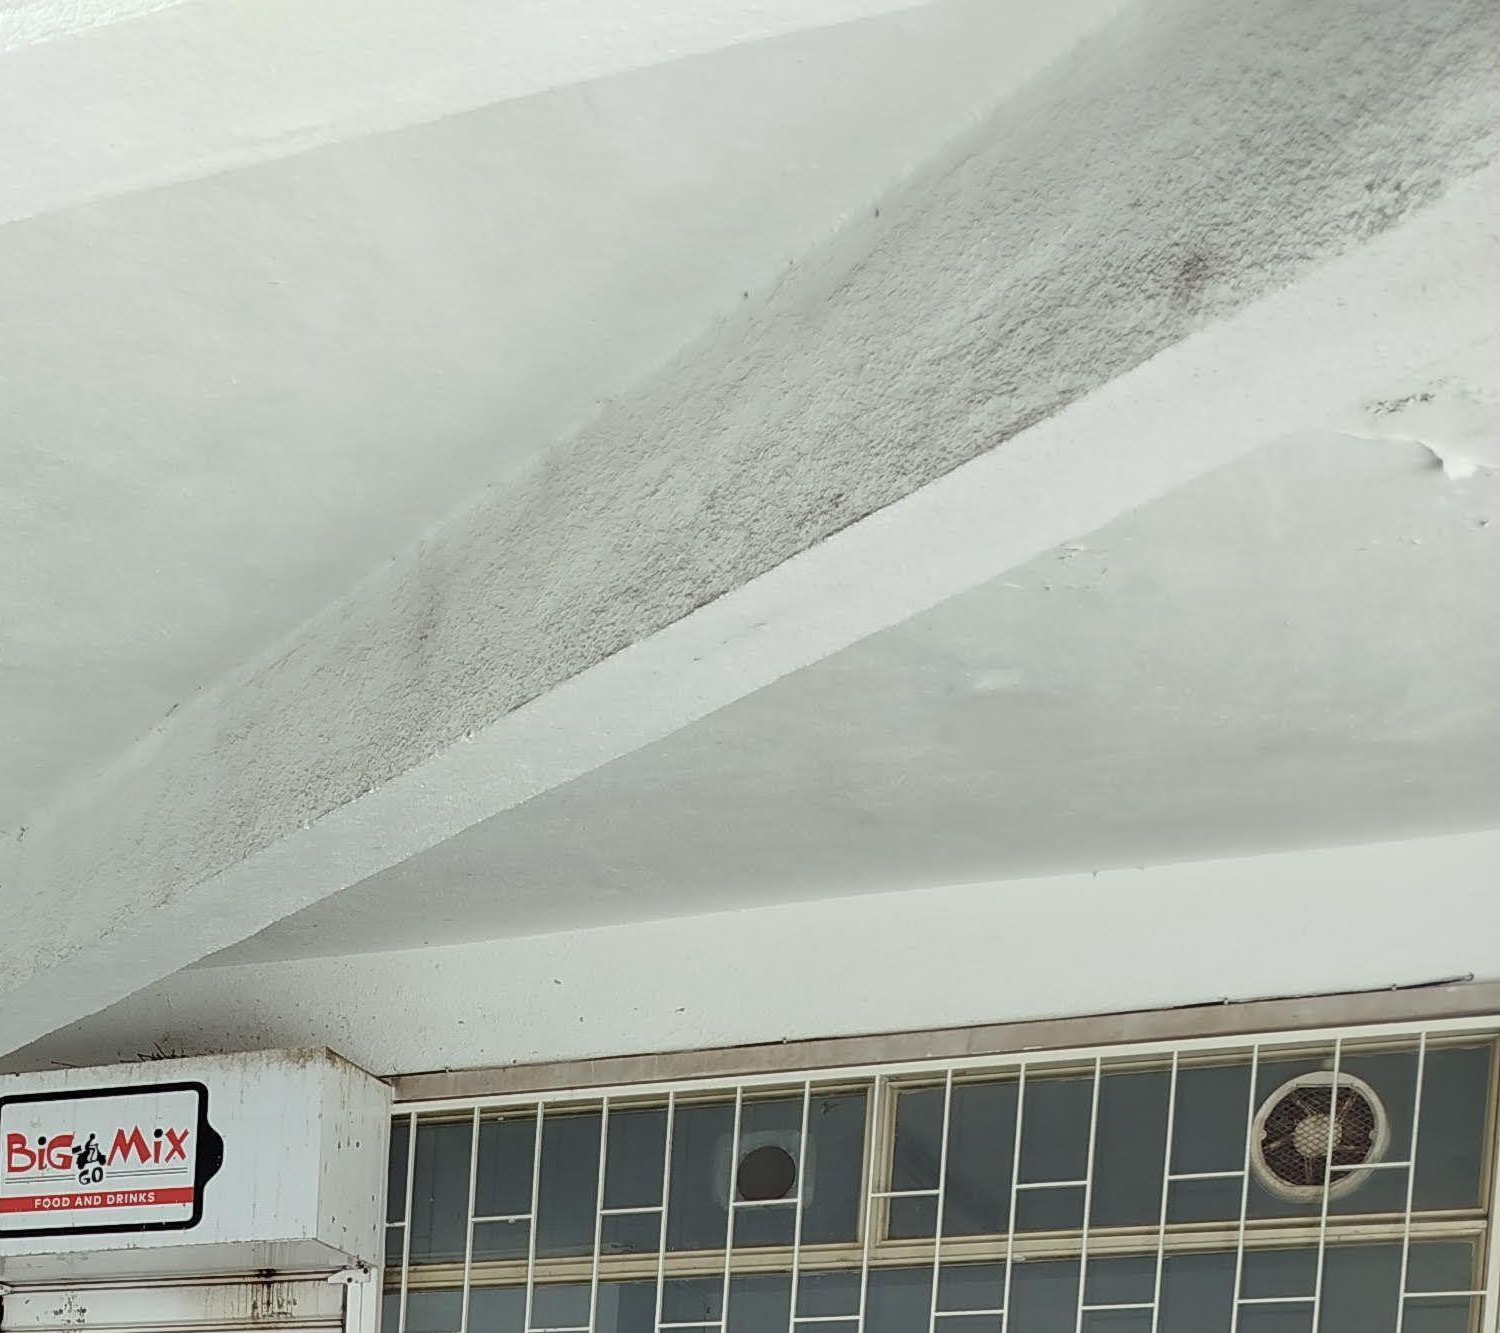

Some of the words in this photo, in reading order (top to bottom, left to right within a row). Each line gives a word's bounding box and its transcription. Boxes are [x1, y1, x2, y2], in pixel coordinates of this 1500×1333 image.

[78, 1167, 104, 1186] GO
[34, 1195, 71, 1209] FOOD
[74, 1194, 102, 1207] AND
[106, 1192, 156, 1205] DRINKS
